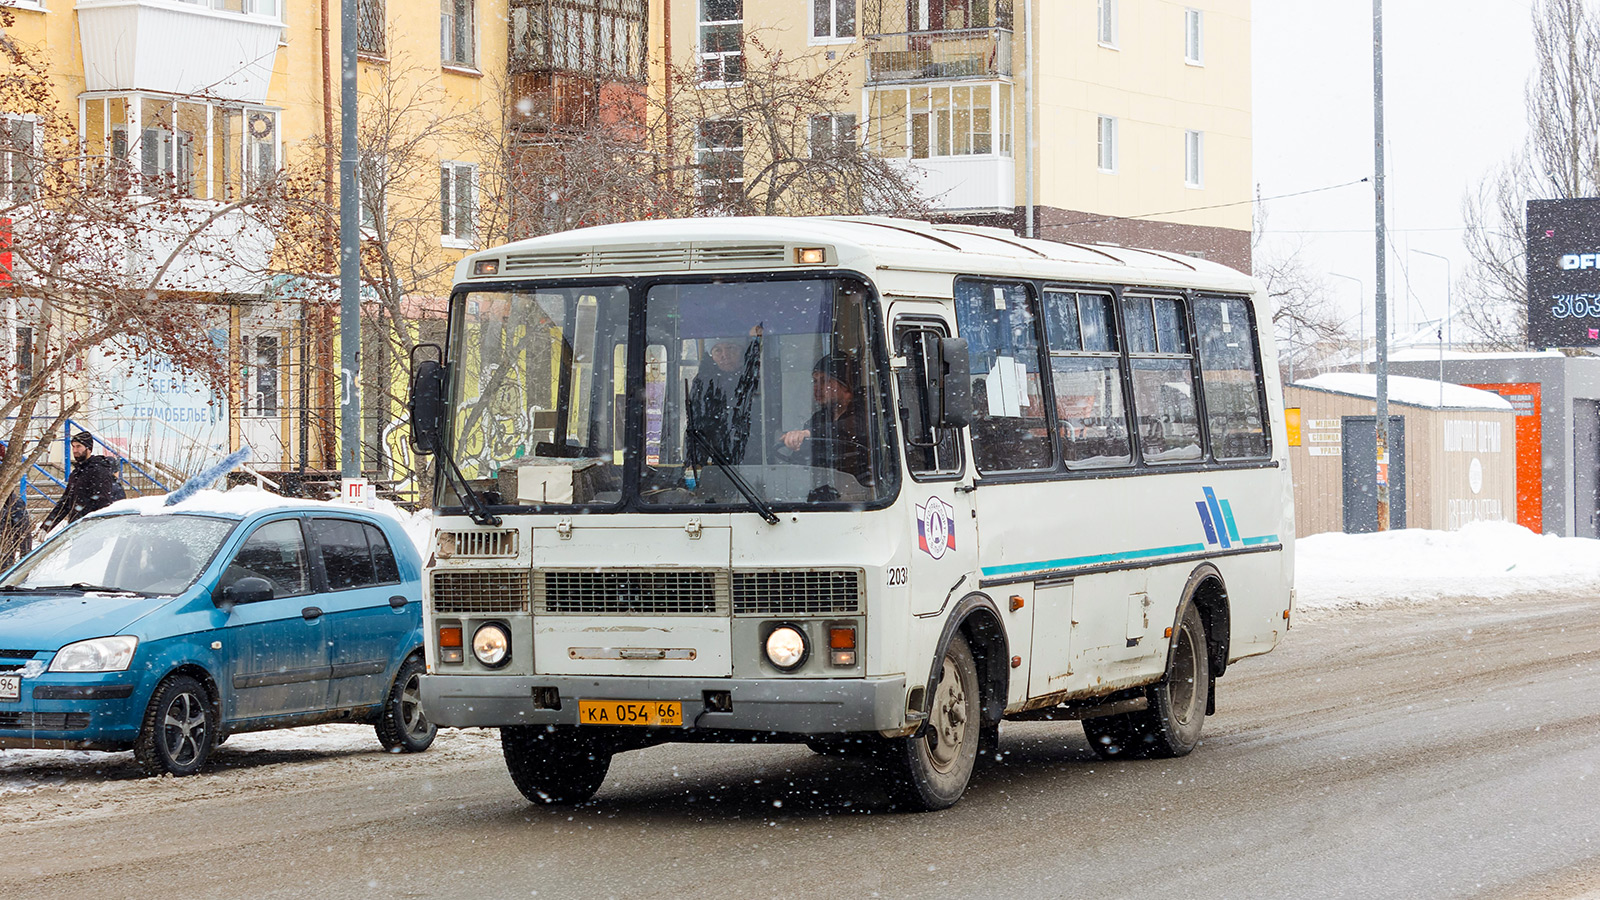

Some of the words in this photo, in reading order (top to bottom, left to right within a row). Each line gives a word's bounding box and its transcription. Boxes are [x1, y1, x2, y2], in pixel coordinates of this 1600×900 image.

[133, 407, 206, 421] ТЕРМОБЕЛЬЕ
[349, 484, 363, 497] ПГ
[616, 704, 648, 721] 054
[658, 704, 675, 717] 66
